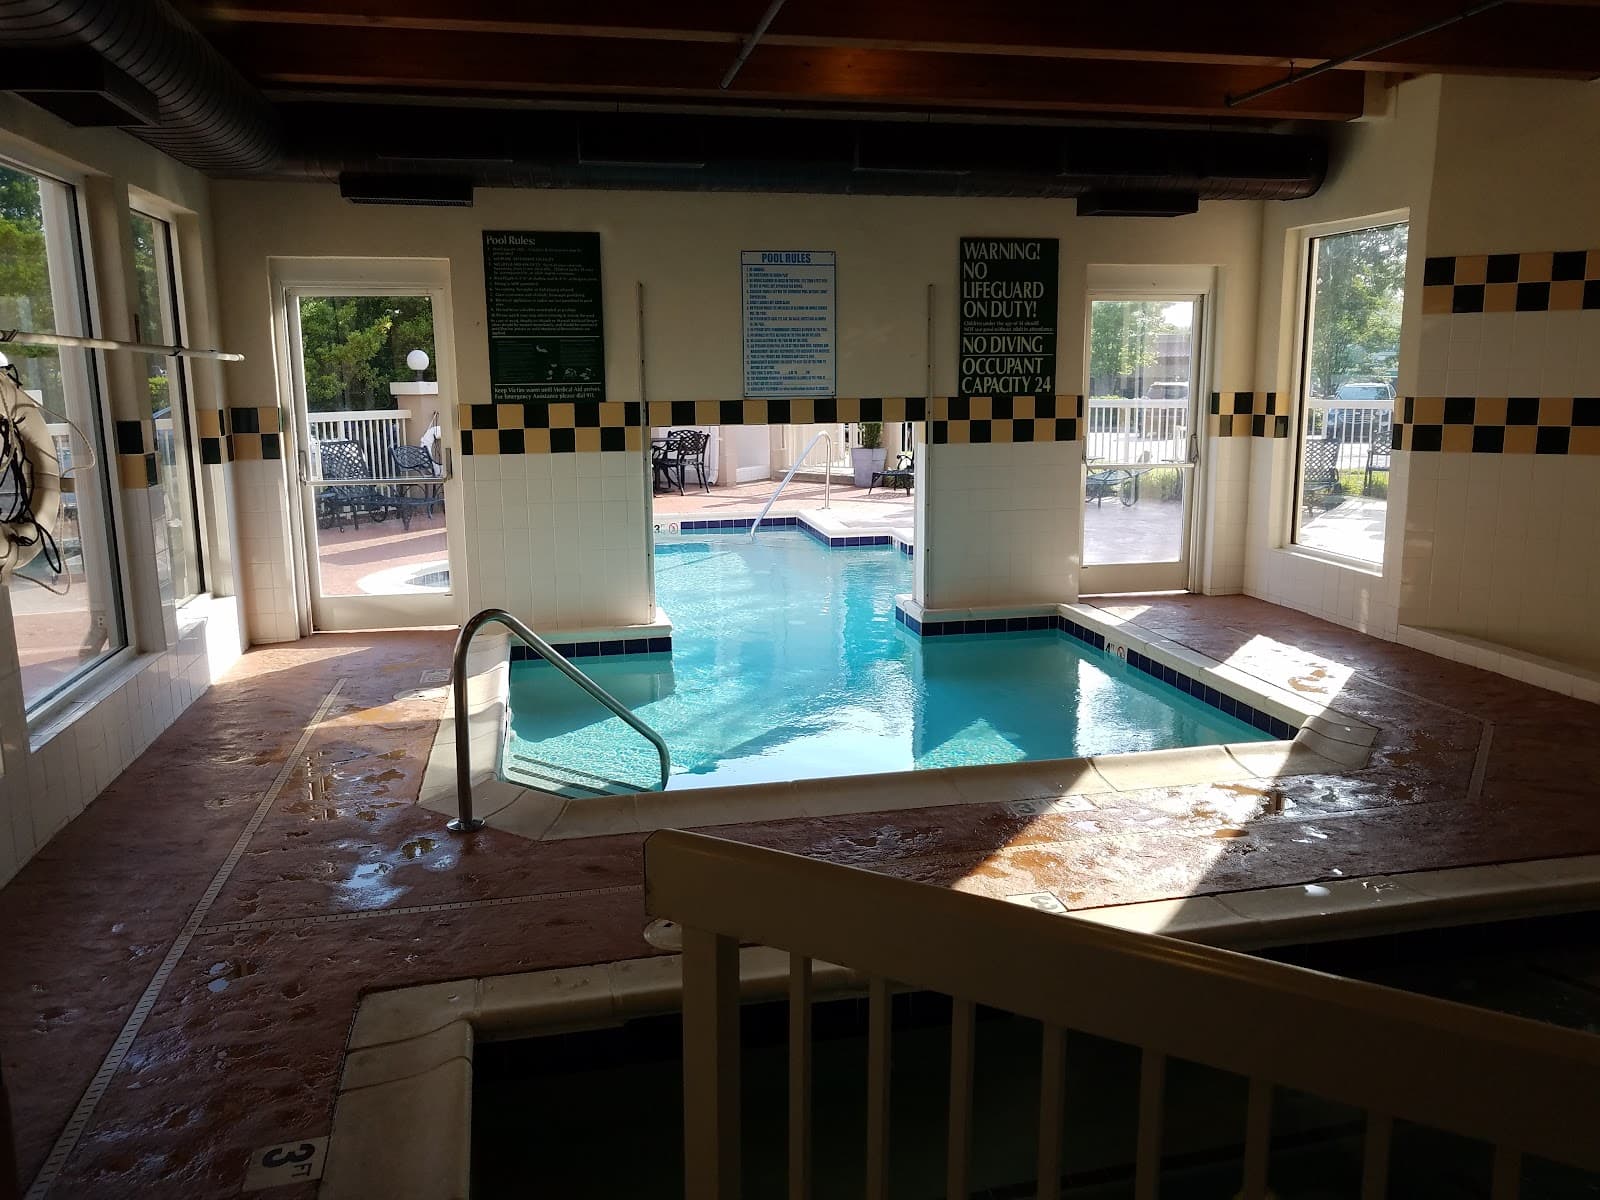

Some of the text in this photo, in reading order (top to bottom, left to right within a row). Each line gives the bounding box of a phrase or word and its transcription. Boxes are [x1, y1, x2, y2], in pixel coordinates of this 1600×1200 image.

[486, 235, 536, 245] Pool Rules:
[761, 253, 811, 263] POOL RULES
[963, 242, 1041, 260] WARNING!
[963, 261, 988, 280] NO
[963, 281, 1044, 299] LIFEGUARD
[963, 300, 1037, 318] ON DUTY!
[962, 335, 1043, 354] NO DIVING
[962, 357, 1044, 375] OCCUPANT
[553, 385, 573, 393] Medical
[961, 375, 1052, 394] CAPACITY 24
[262, 1143, 316, 1178] 3 FT
